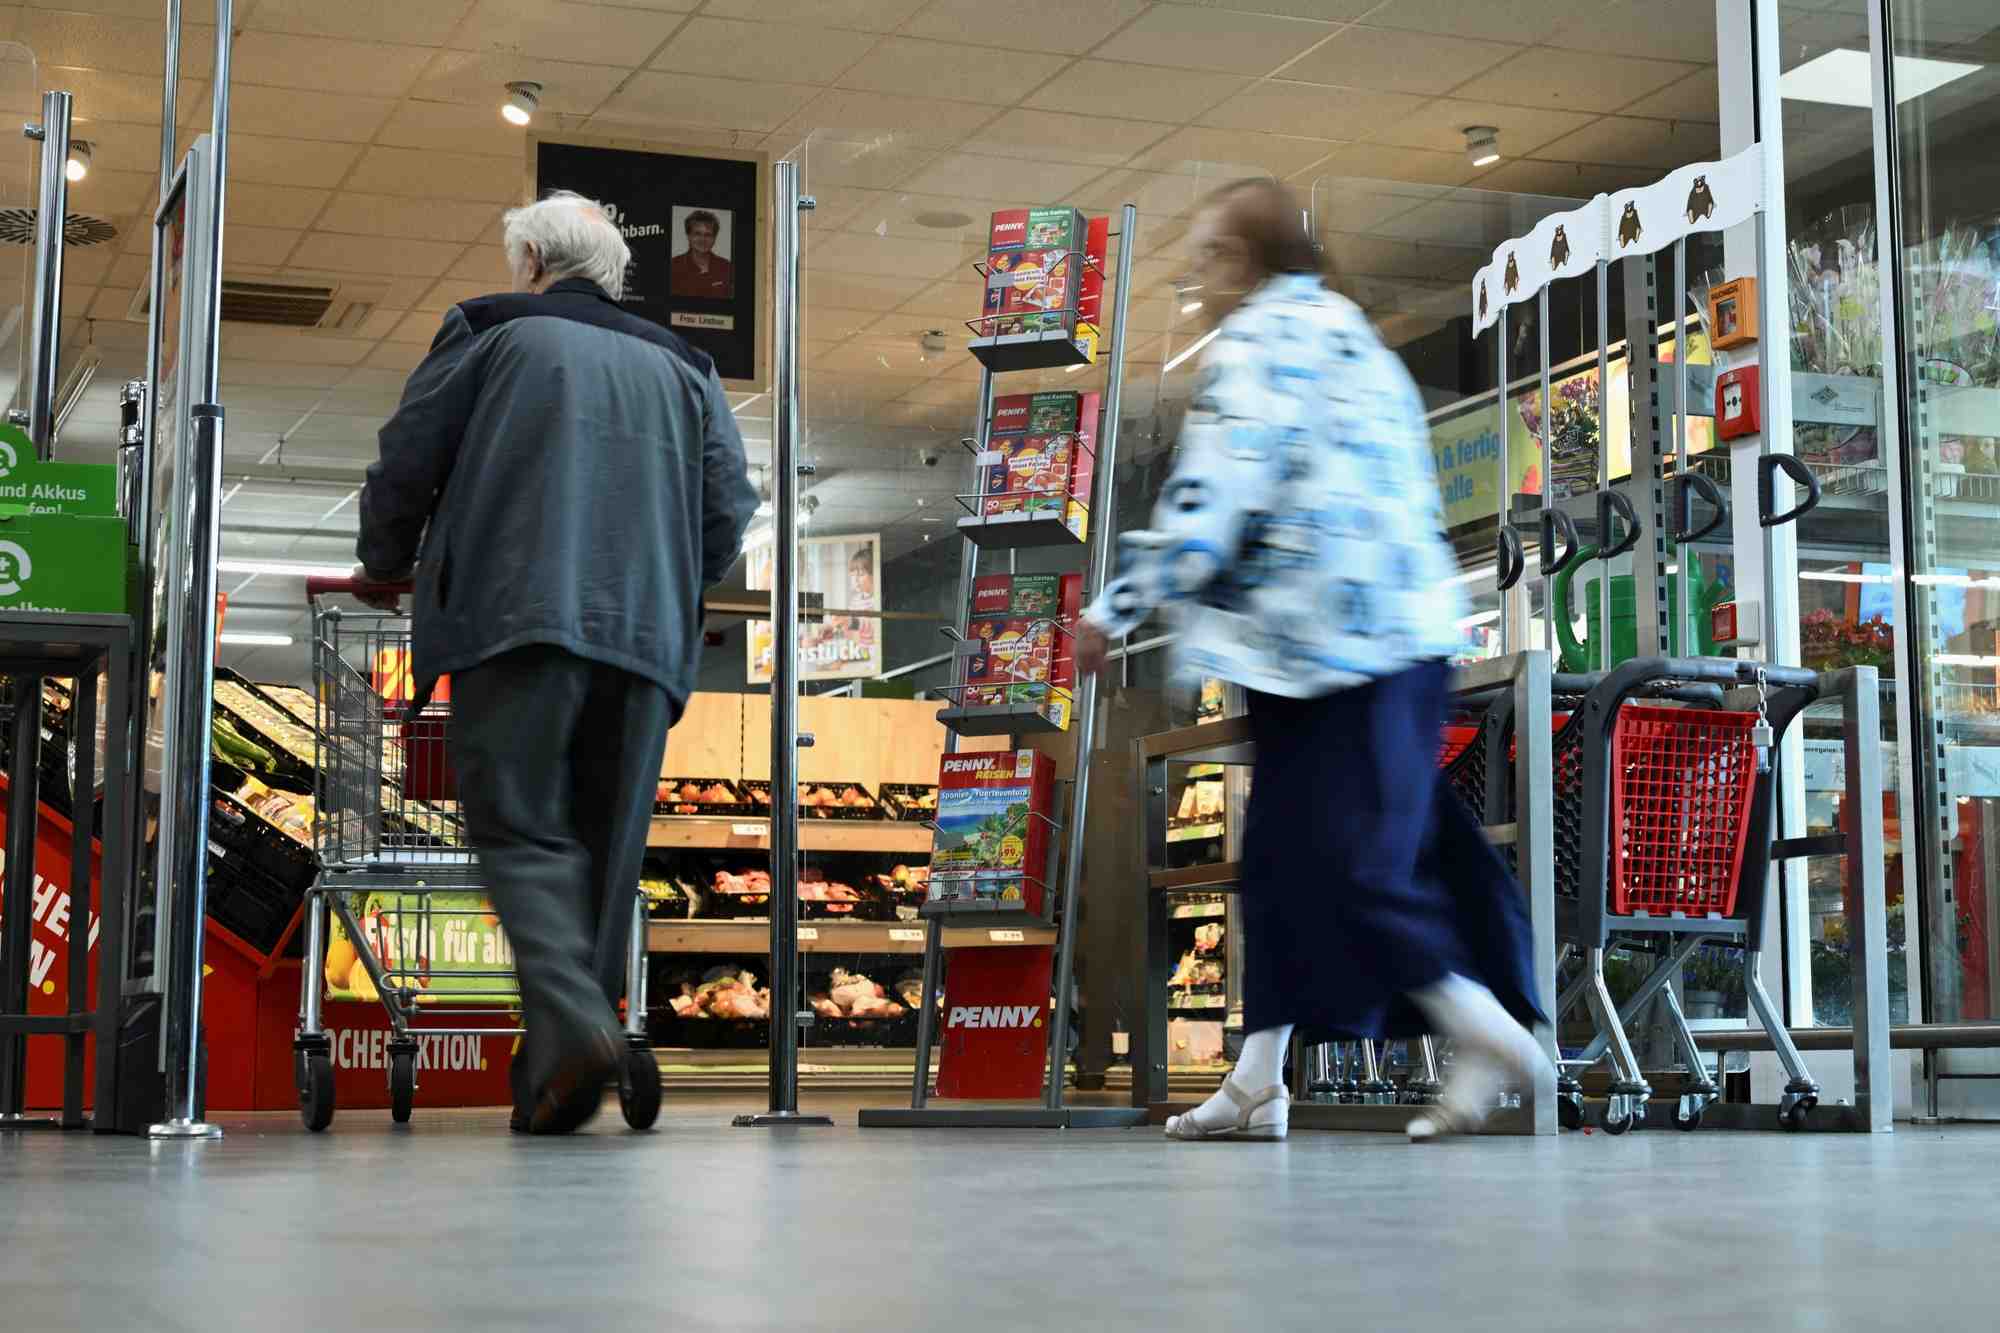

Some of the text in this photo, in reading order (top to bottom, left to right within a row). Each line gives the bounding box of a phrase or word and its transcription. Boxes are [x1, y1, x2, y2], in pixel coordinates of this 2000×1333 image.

[620, 224, 665, 238] hbarn.
[31, 484, 87, 501] Akkus
[943, 758, 996, 773] PENNY.
[975, 769, 1015, 780] REISEN
[443, 919, 478, 963] für
[947, 1005, 1042, 1029] PENNY.
